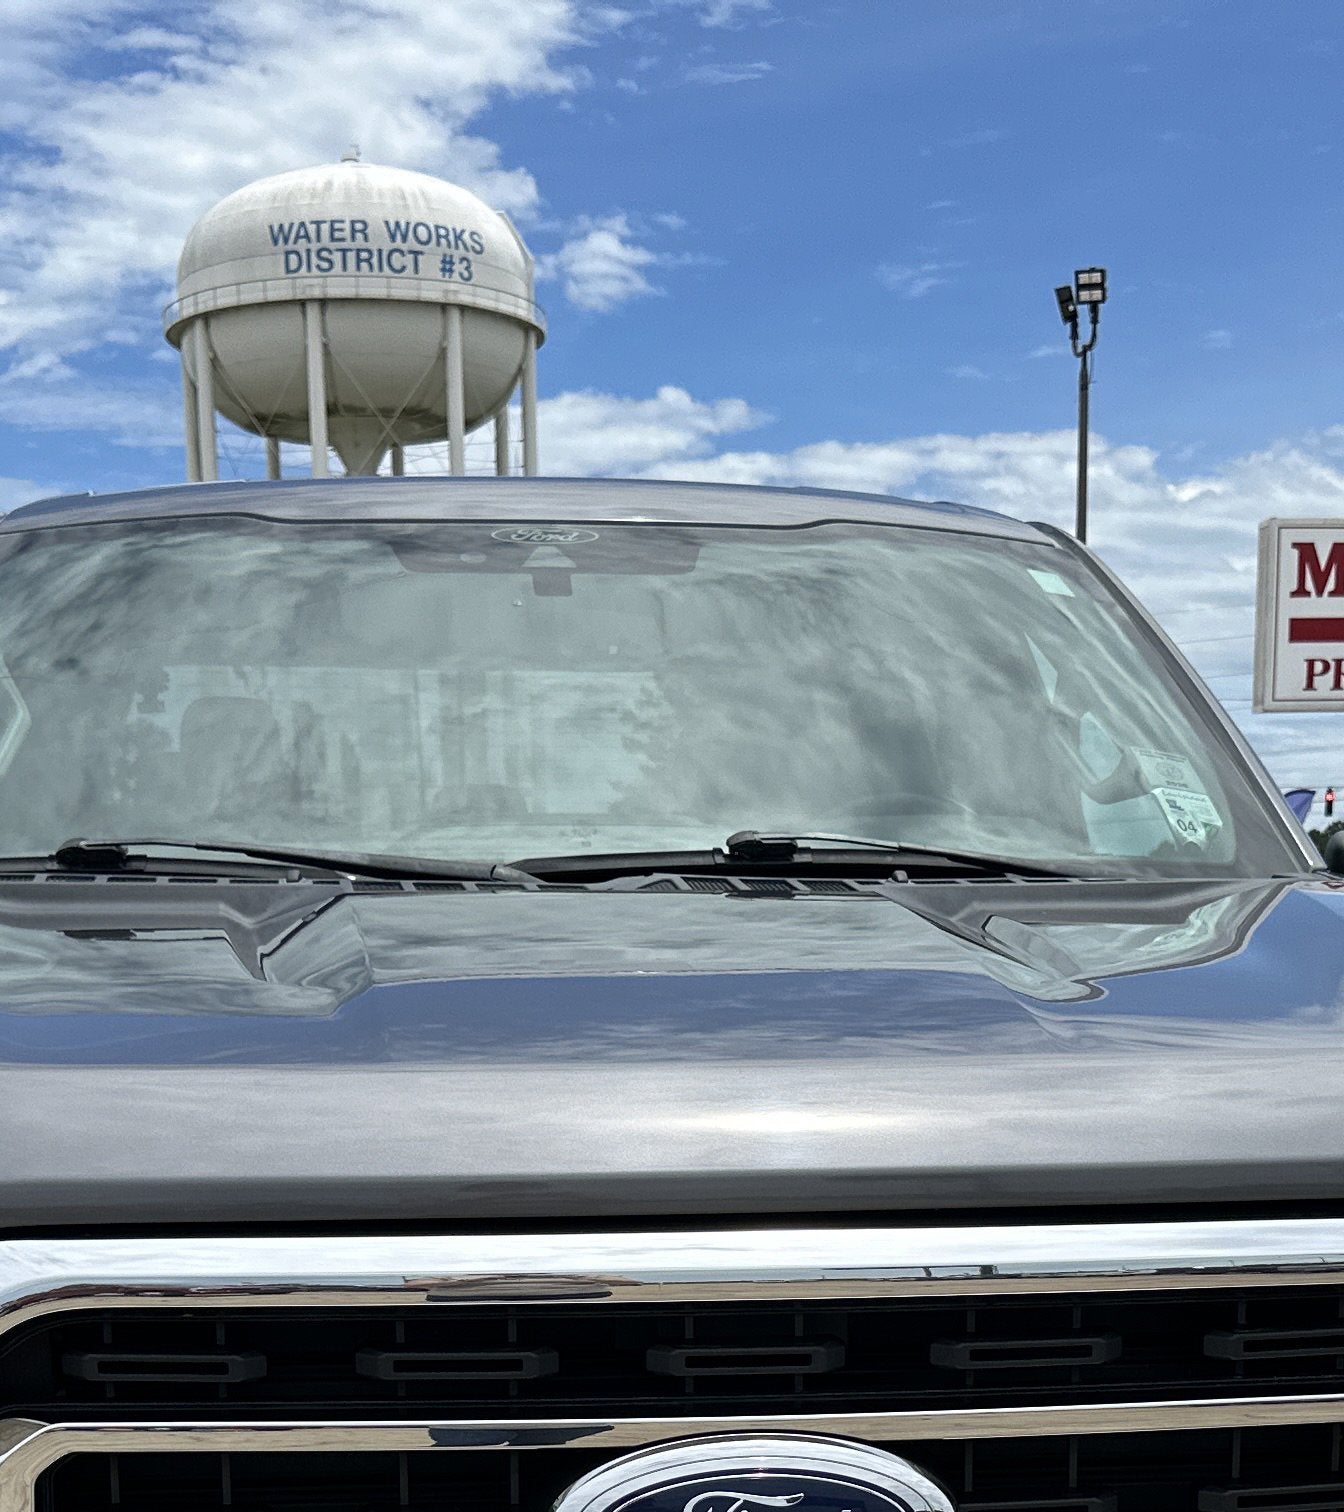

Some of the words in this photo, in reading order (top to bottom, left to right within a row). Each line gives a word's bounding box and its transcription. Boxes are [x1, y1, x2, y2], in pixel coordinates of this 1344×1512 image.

[269, 219, 369, 247] WATER
[384, 220, 485, 256] WORKS
[284, 248, 425, 276] DISTRICT
[439, 255, 474, 282] #3
[511, 526, 580, 541] Ford
[1177, 819, 1198, 833] 04
